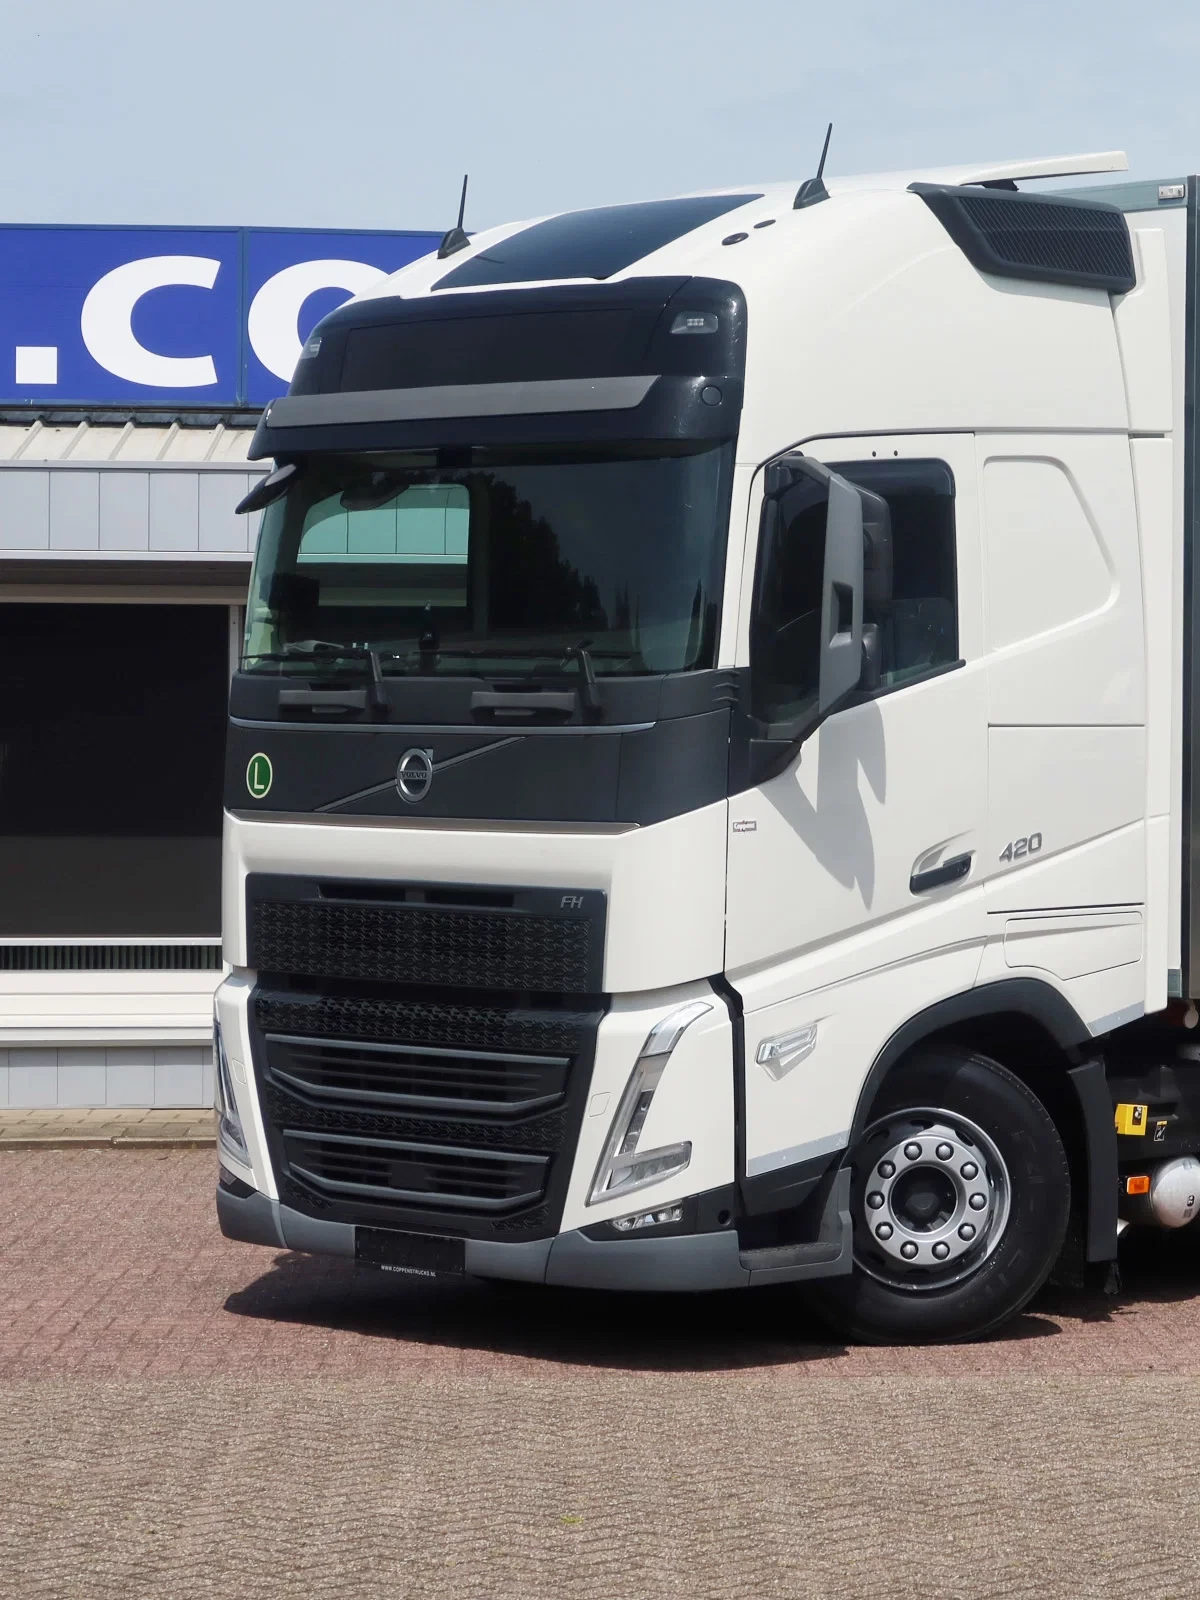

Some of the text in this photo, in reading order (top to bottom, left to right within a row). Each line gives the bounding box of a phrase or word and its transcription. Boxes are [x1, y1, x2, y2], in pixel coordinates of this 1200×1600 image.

[254, 762, 264, 790] L
[400, 770, 427, 780] VOLVO
[998, 832, 1042, 862] 420
[560, 895, 584, 909] FH
